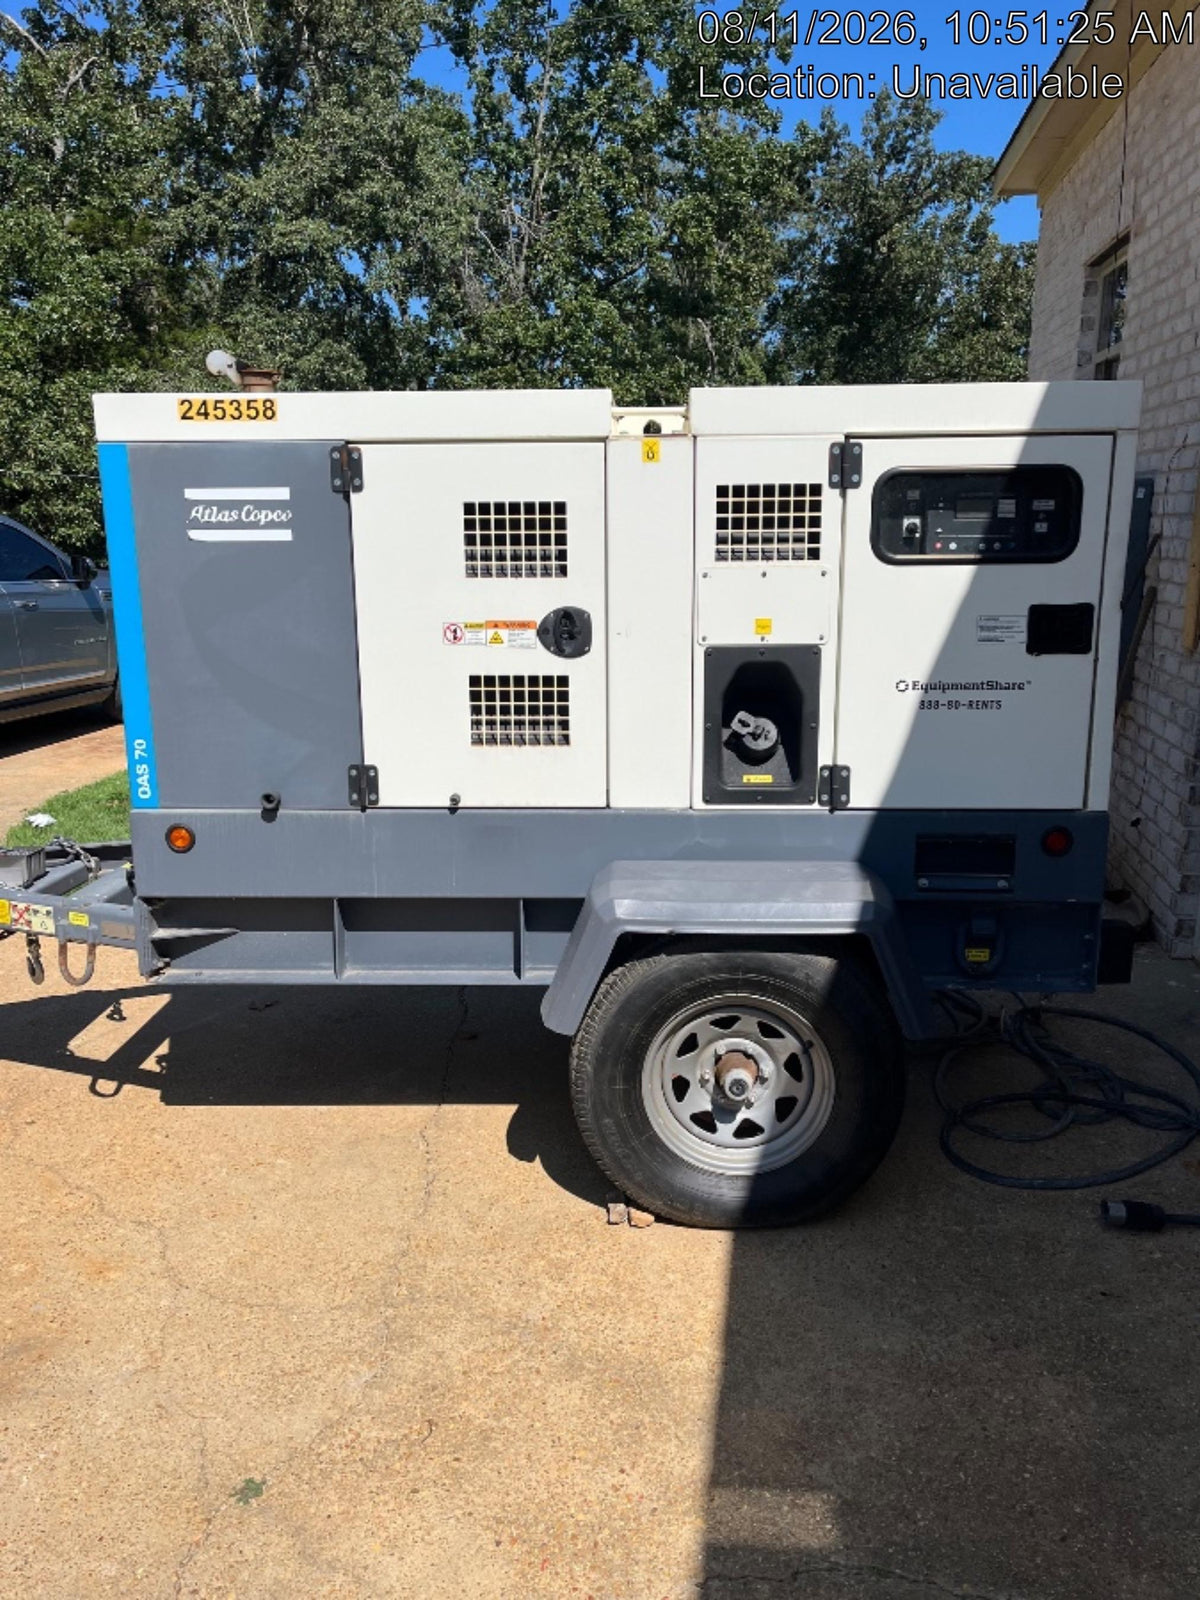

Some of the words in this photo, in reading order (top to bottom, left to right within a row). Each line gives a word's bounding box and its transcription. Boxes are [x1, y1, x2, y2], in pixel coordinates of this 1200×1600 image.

[180, 399, 276, 420] 245358
[188, 504, 239, 523] Atlas
[241, 504, 293, 526] Copco
[134, 739, 148, 760] 70
[136, 764, 152, 799] QAS
